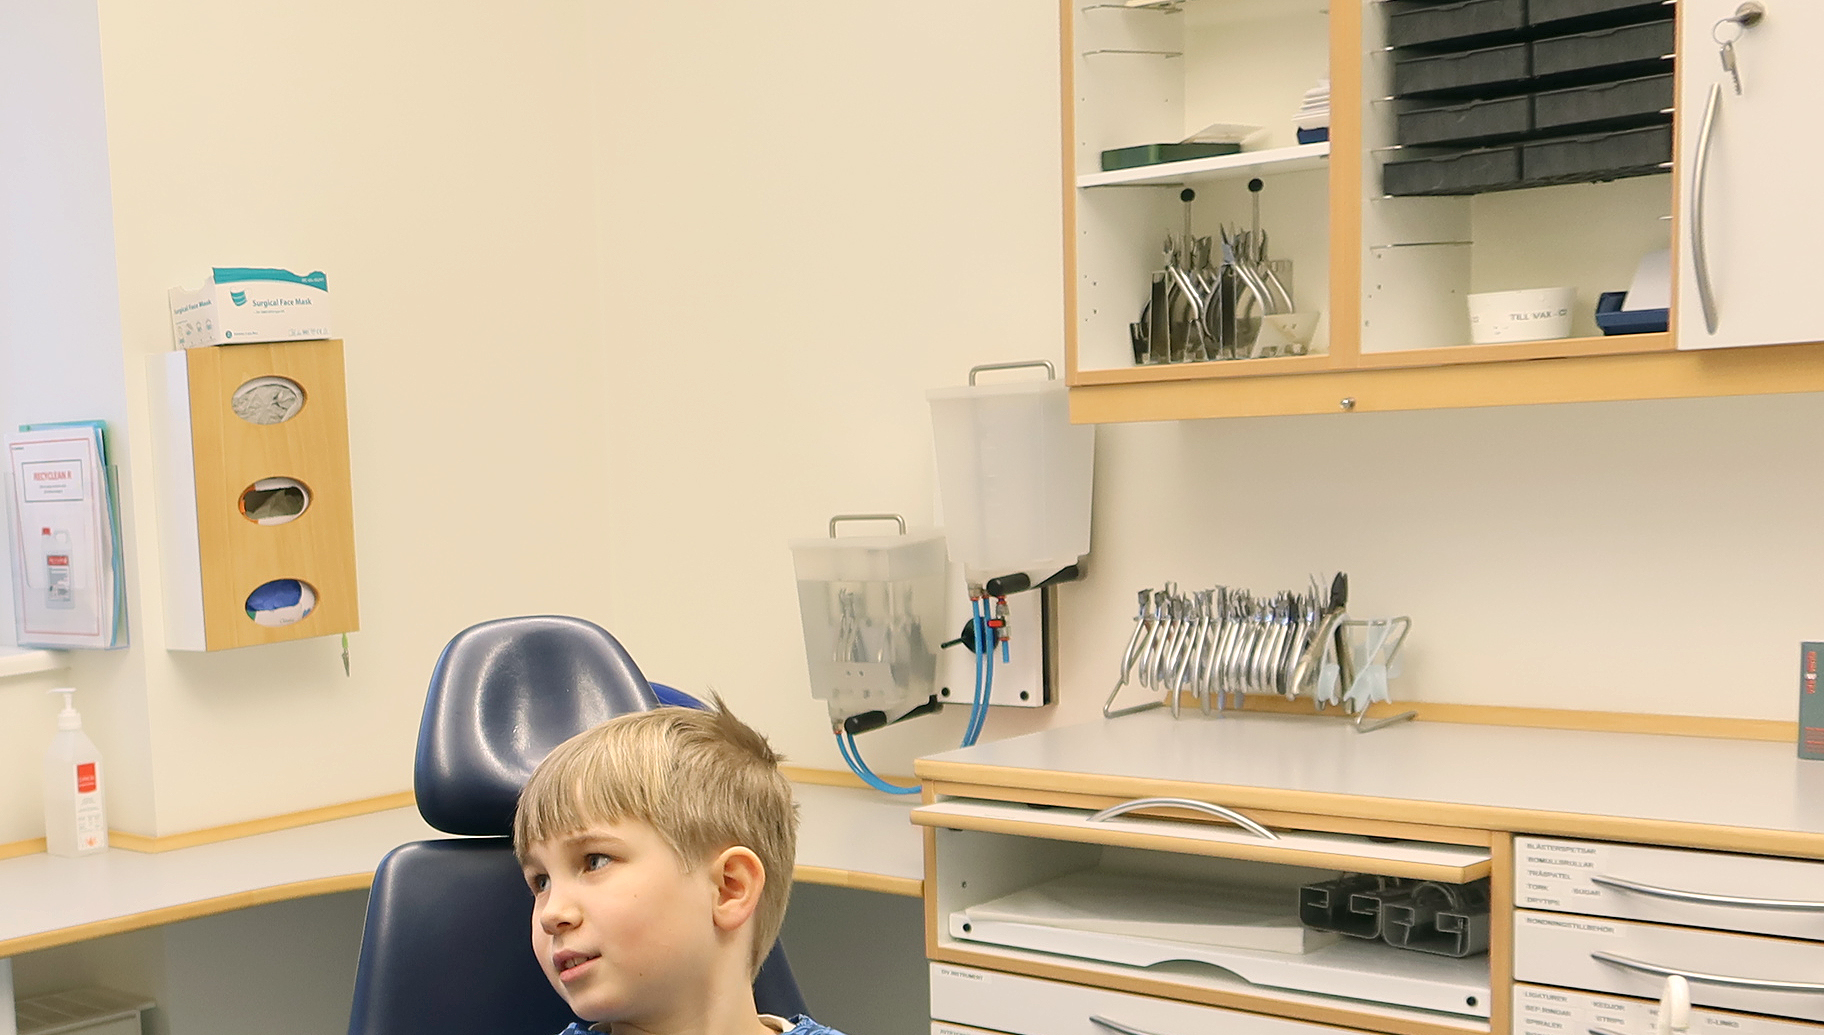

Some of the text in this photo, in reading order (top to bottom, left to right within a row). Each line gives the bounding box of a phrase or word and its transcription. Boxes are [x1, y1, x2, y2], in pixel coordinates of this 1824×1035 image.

[252, 299, 279, 308] Surgical
[1510, 311, 1552, 321] TILL VAX
